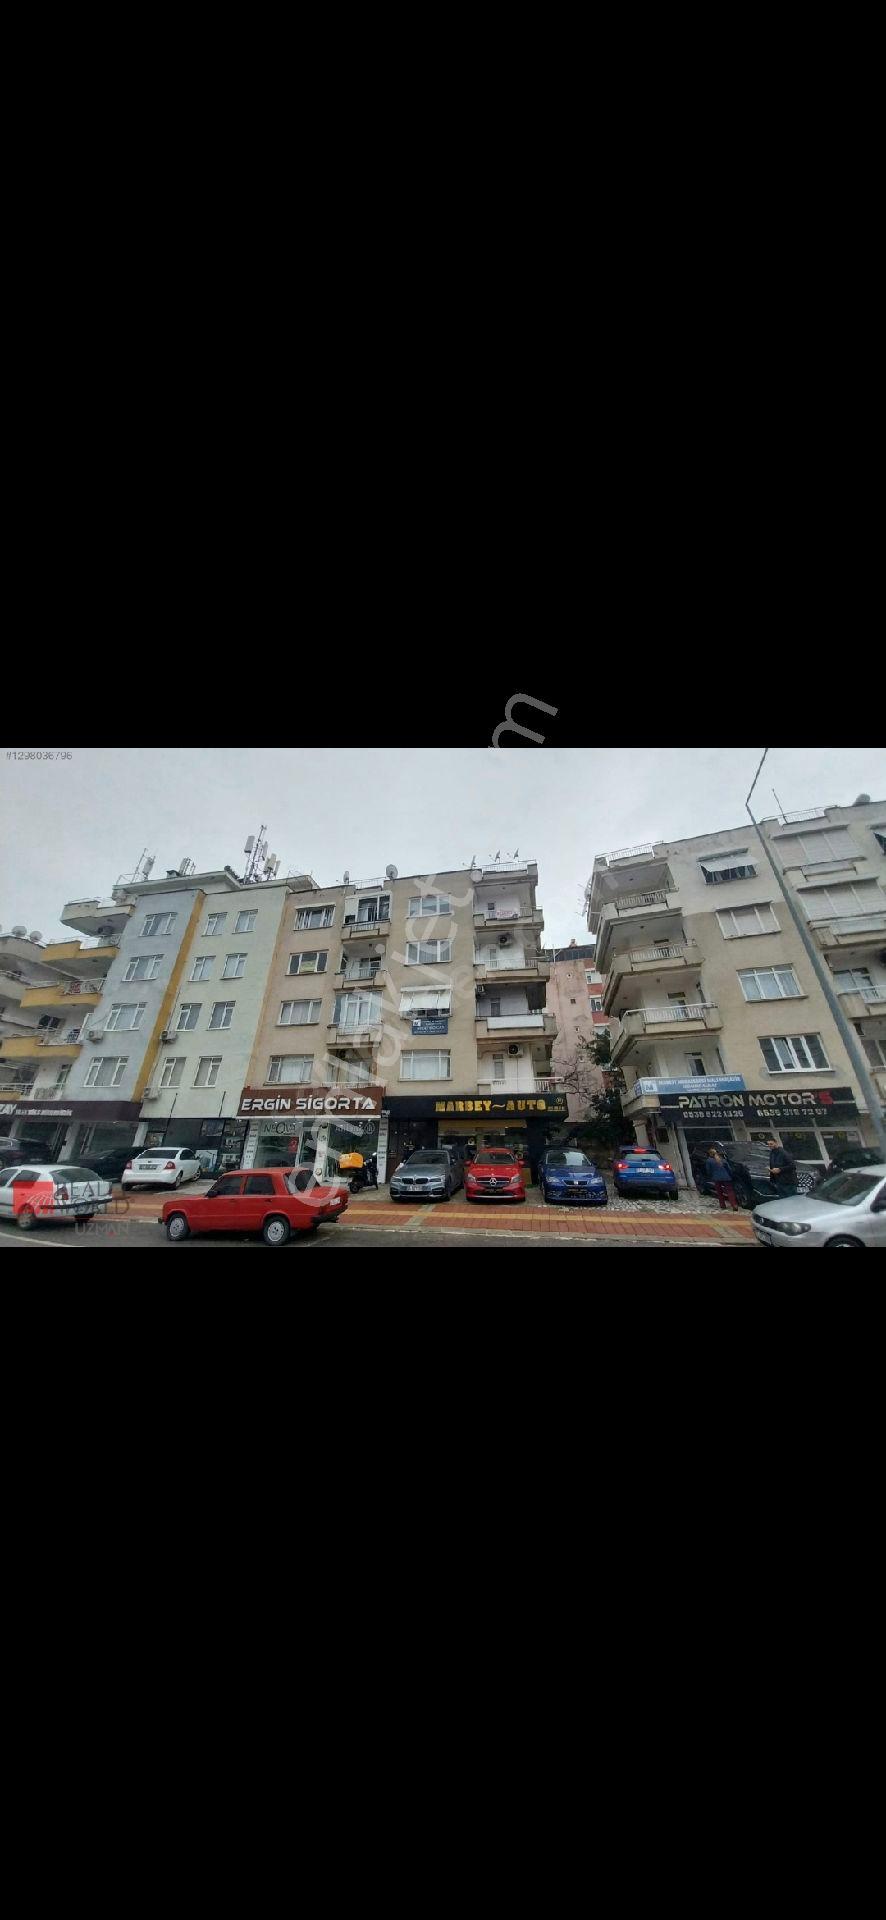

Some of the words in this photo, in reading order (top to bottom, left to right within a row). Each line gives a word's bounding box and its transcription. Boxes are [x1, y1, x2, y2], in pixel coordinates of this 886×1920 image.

[241, 1095, 291, 1111] ERGİN
[295, 1094, 376, 1110] SİGORTA
[678, 1093, 745, 1108] PATRON
